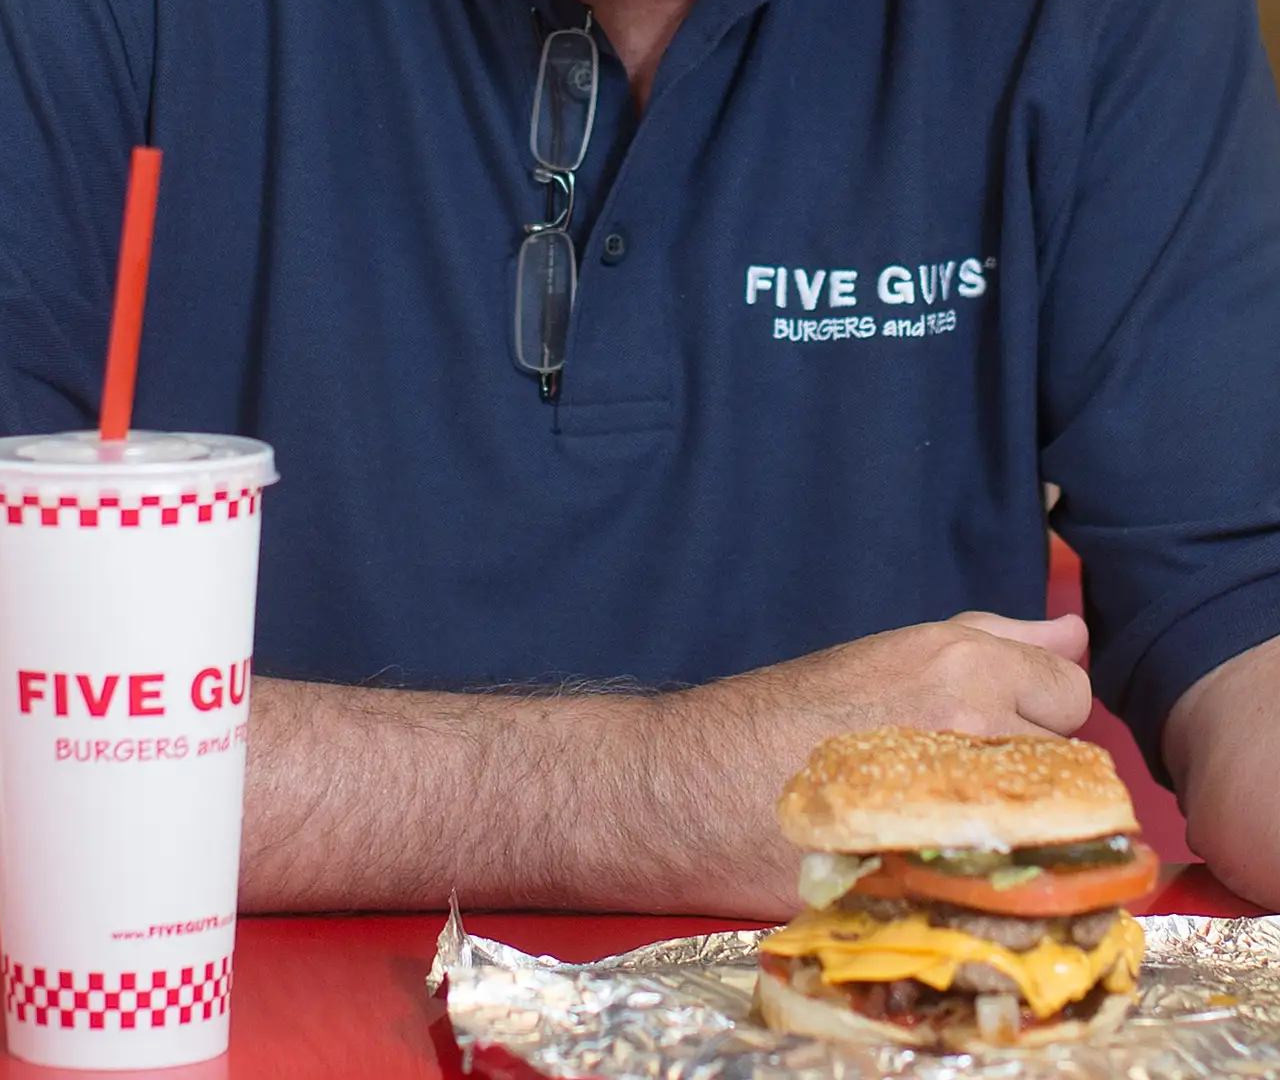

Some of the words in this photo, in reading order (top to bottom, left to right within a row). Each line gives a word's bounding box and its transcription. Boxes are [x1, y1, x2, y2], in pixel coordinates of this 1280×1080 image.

[745, 265, 858, 311] FIVE
[877, 258, 987, 305] GUYS
[772, 316, 876, 343] BURGERS
[882, 313, 925, 337] and
[17, 669, 167, 718] FIVE
[54, 736, 190, 763] BURGERS
[196, 728, 231, 757] and
